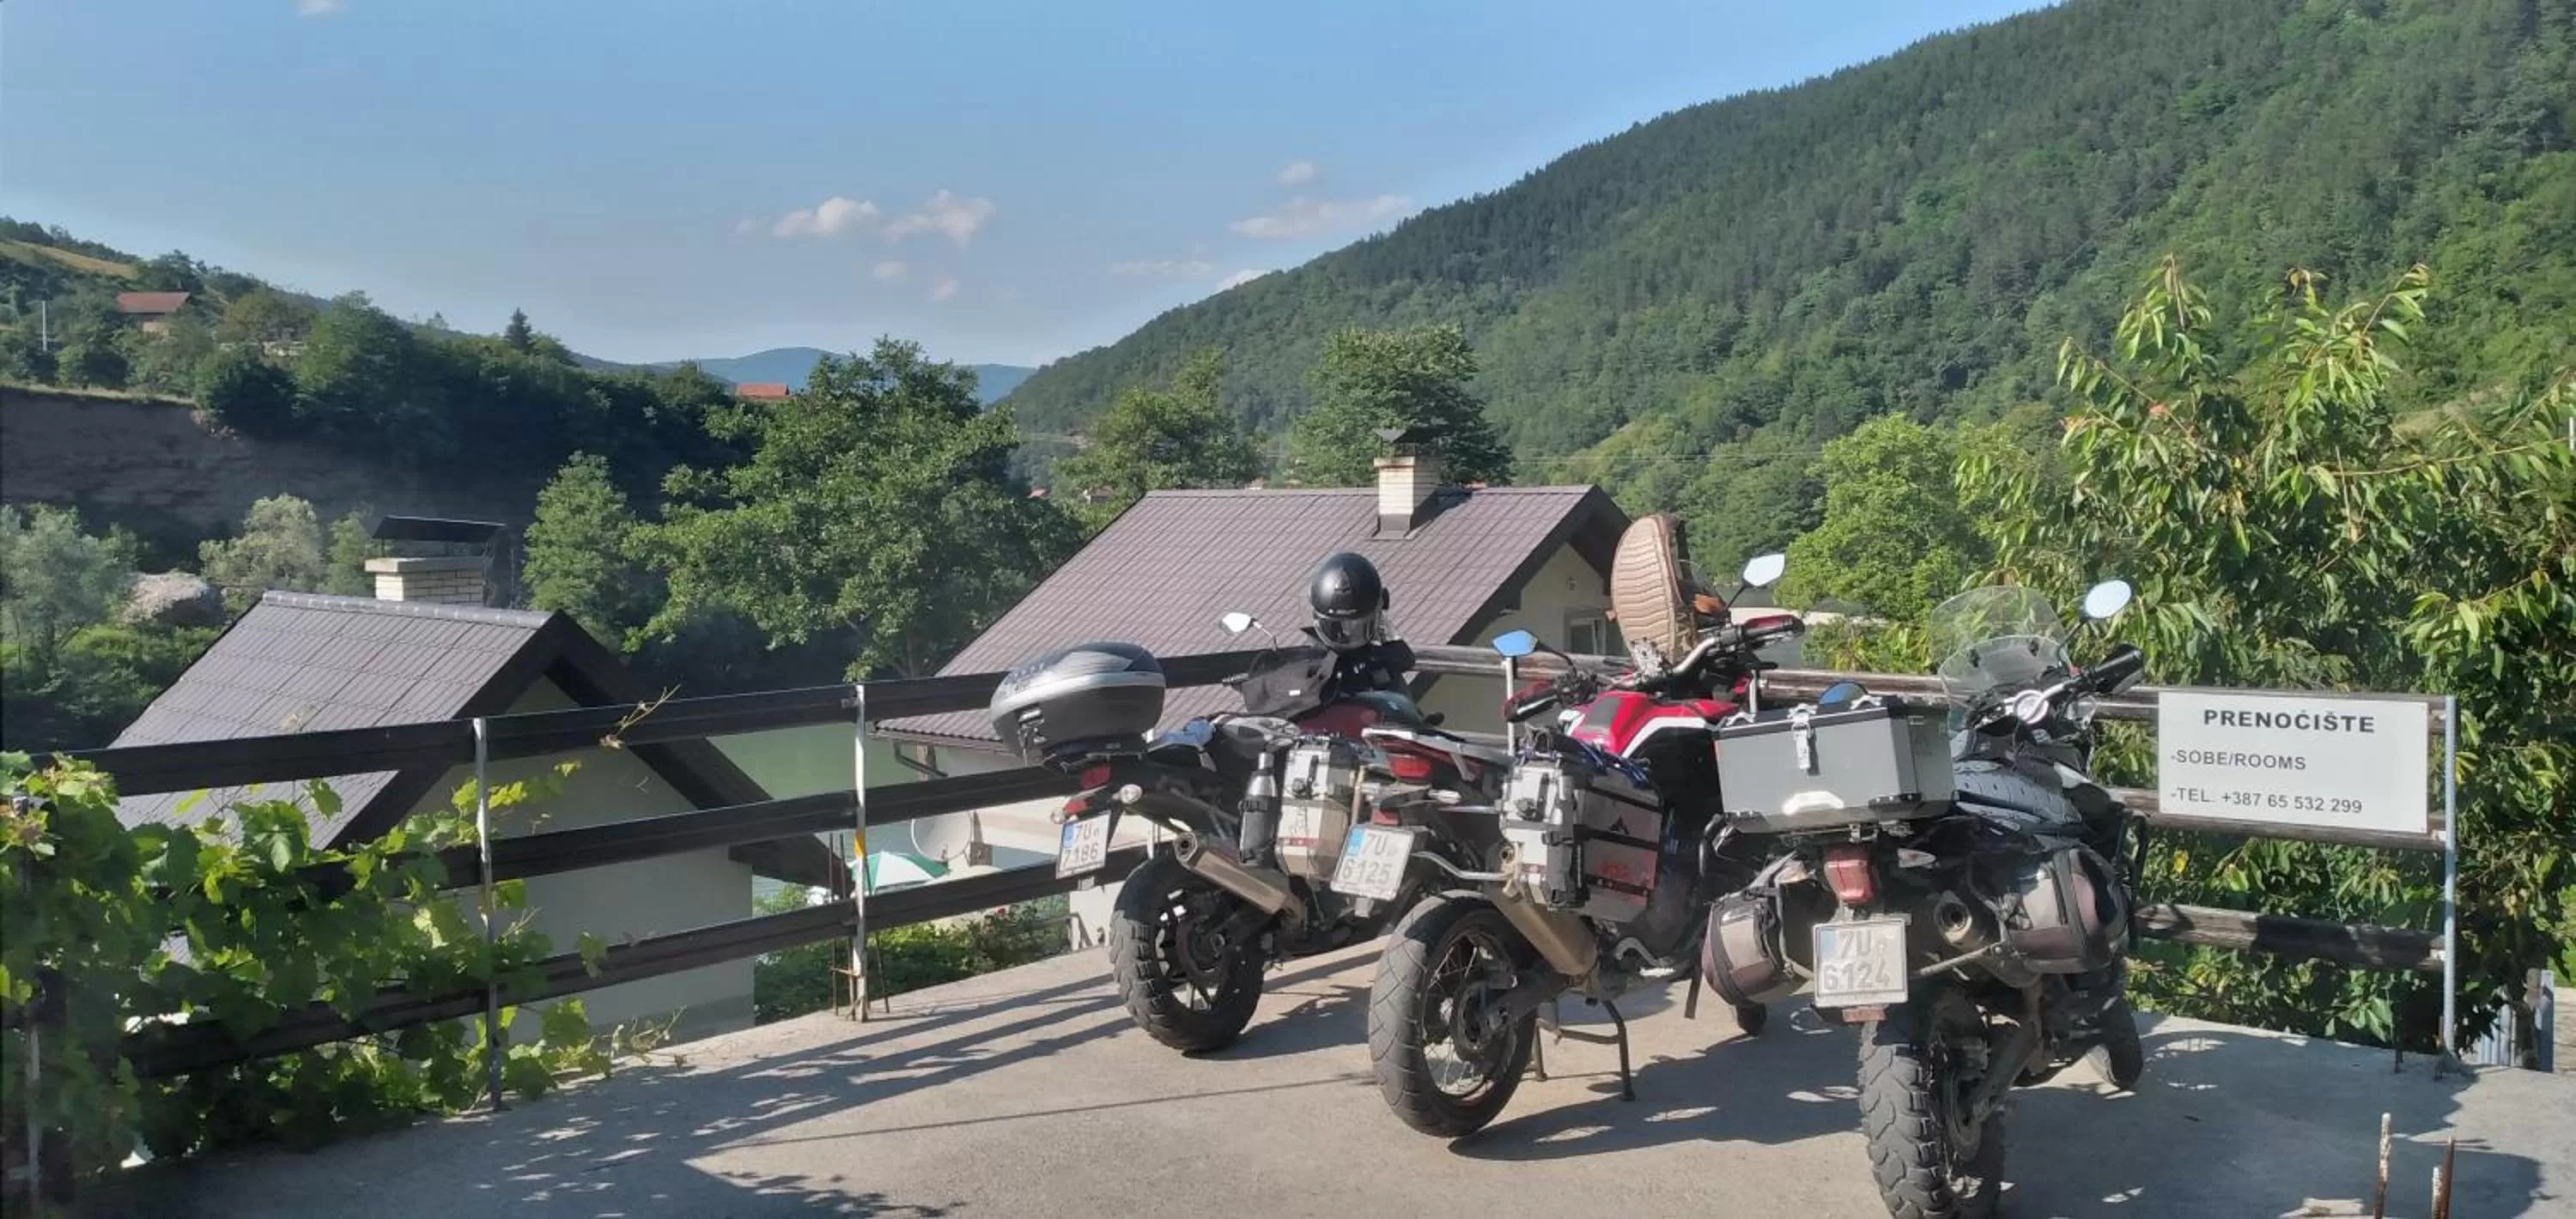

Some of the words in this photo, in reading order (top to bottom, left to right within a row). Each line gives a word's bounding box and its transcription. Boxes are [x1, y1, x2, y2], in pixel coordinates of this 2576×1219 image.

[2221, 791, 2261, 807] +387
[2268, 793, 2289, 809] 65
[2293, 795, 2324, 811] 532
[2331, 798, 2362, 814] 299
[1362, 833, 1388, 856] 7U
[1341, 858, 1394, 884] 6125
[1838, 930, 1872, 959] 7U
[1823, 961, 1890, 991] 6124
